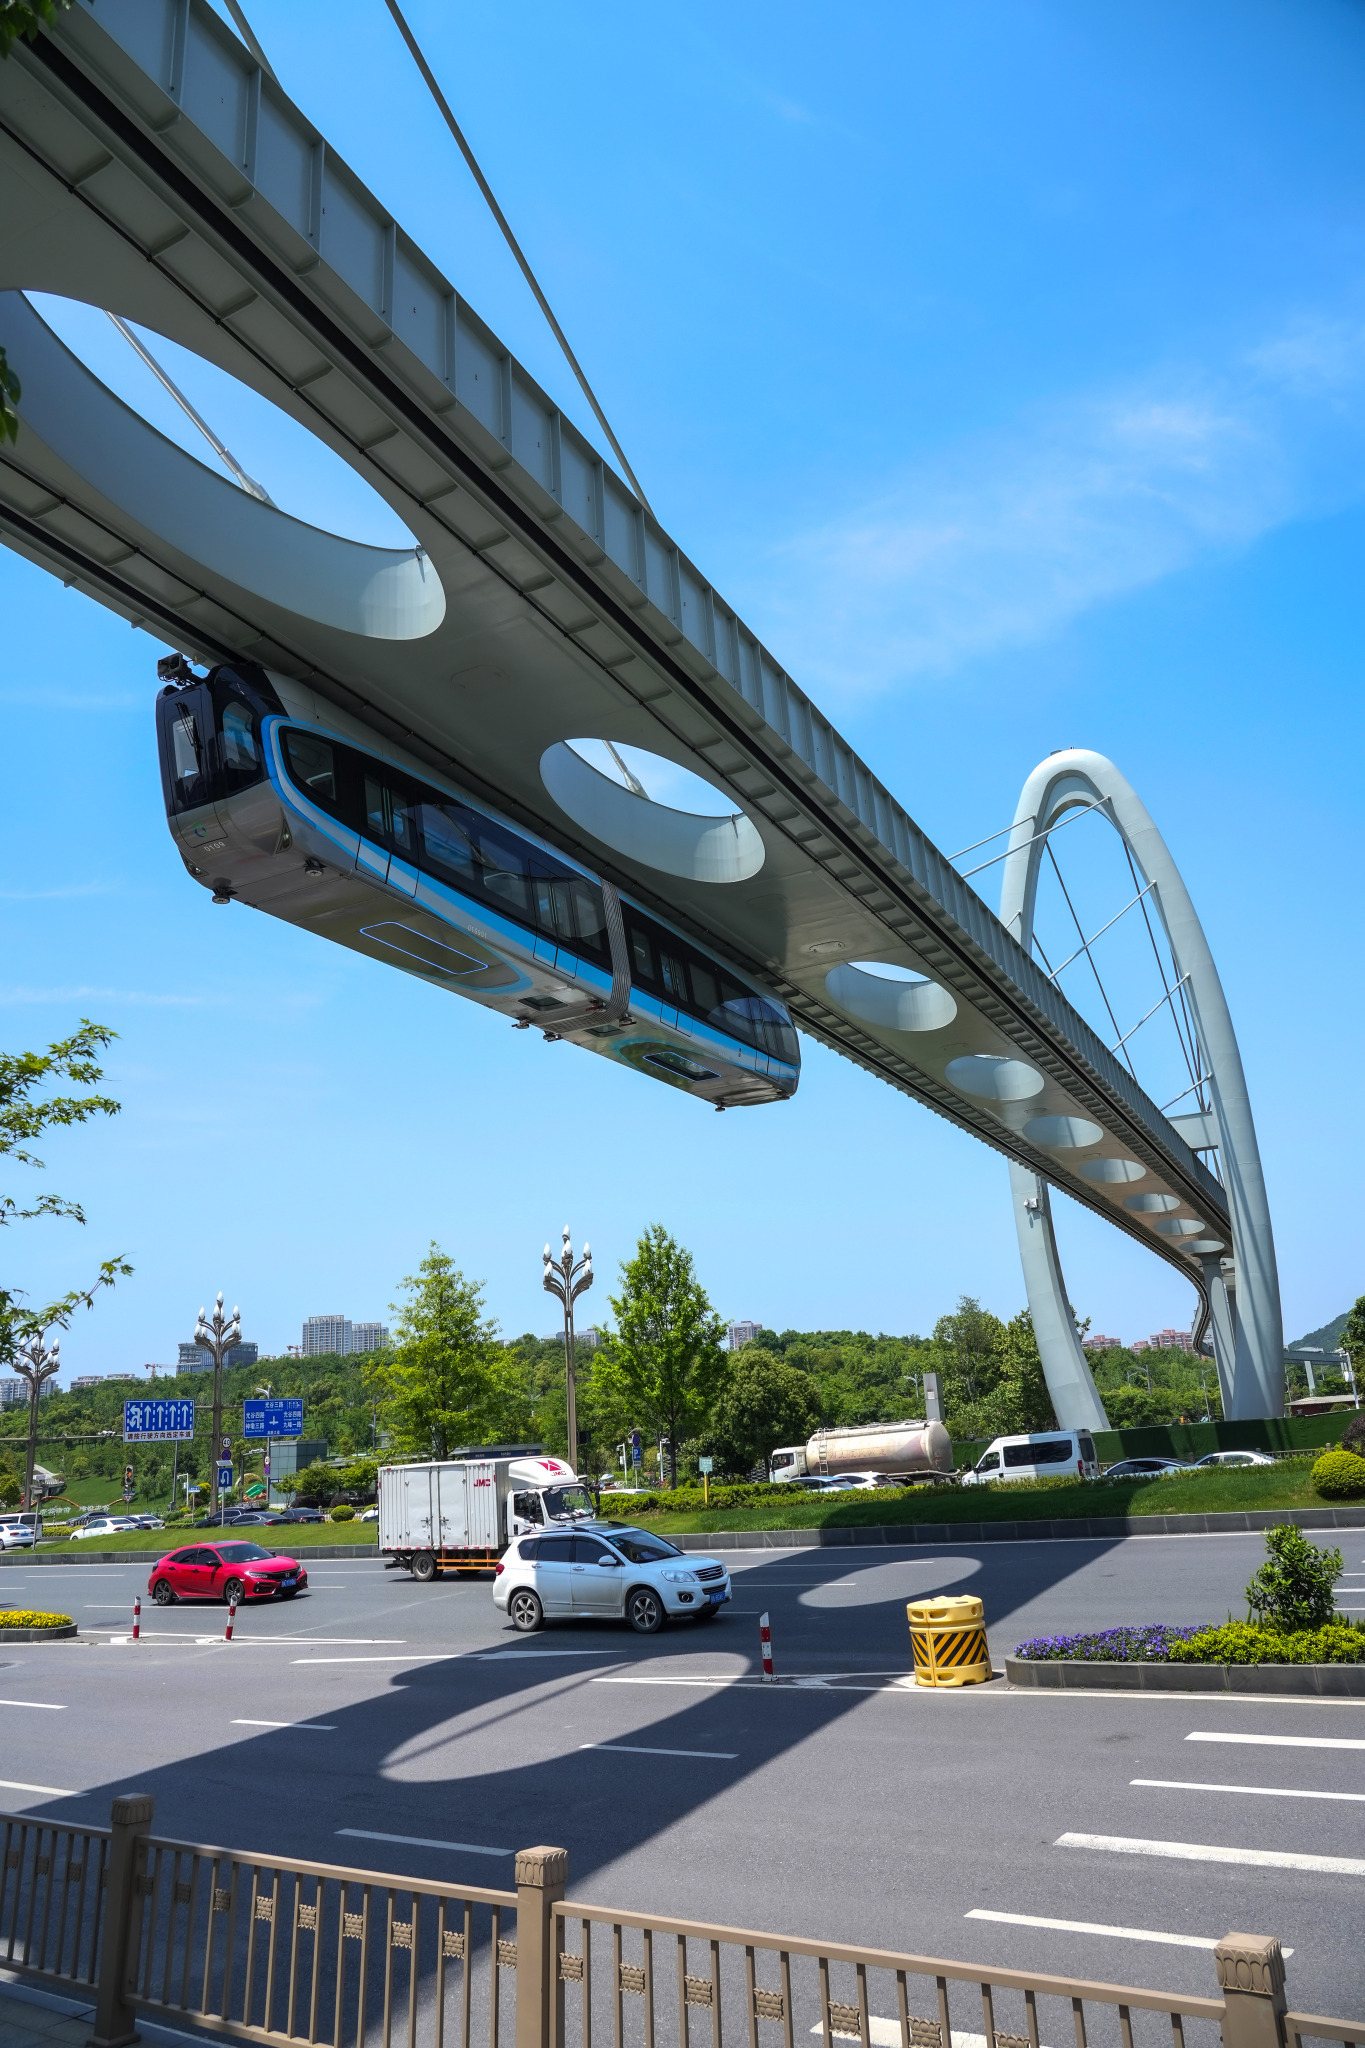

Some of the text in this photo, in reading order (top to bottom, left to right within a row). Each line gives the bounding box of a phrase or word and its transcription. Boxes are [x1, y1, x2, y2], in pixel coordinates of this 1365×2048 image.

[204, 841, 225, 852] 0109
[634, 1449, 639, 1459] P
[474, 1479, 490, 1487] JMC
